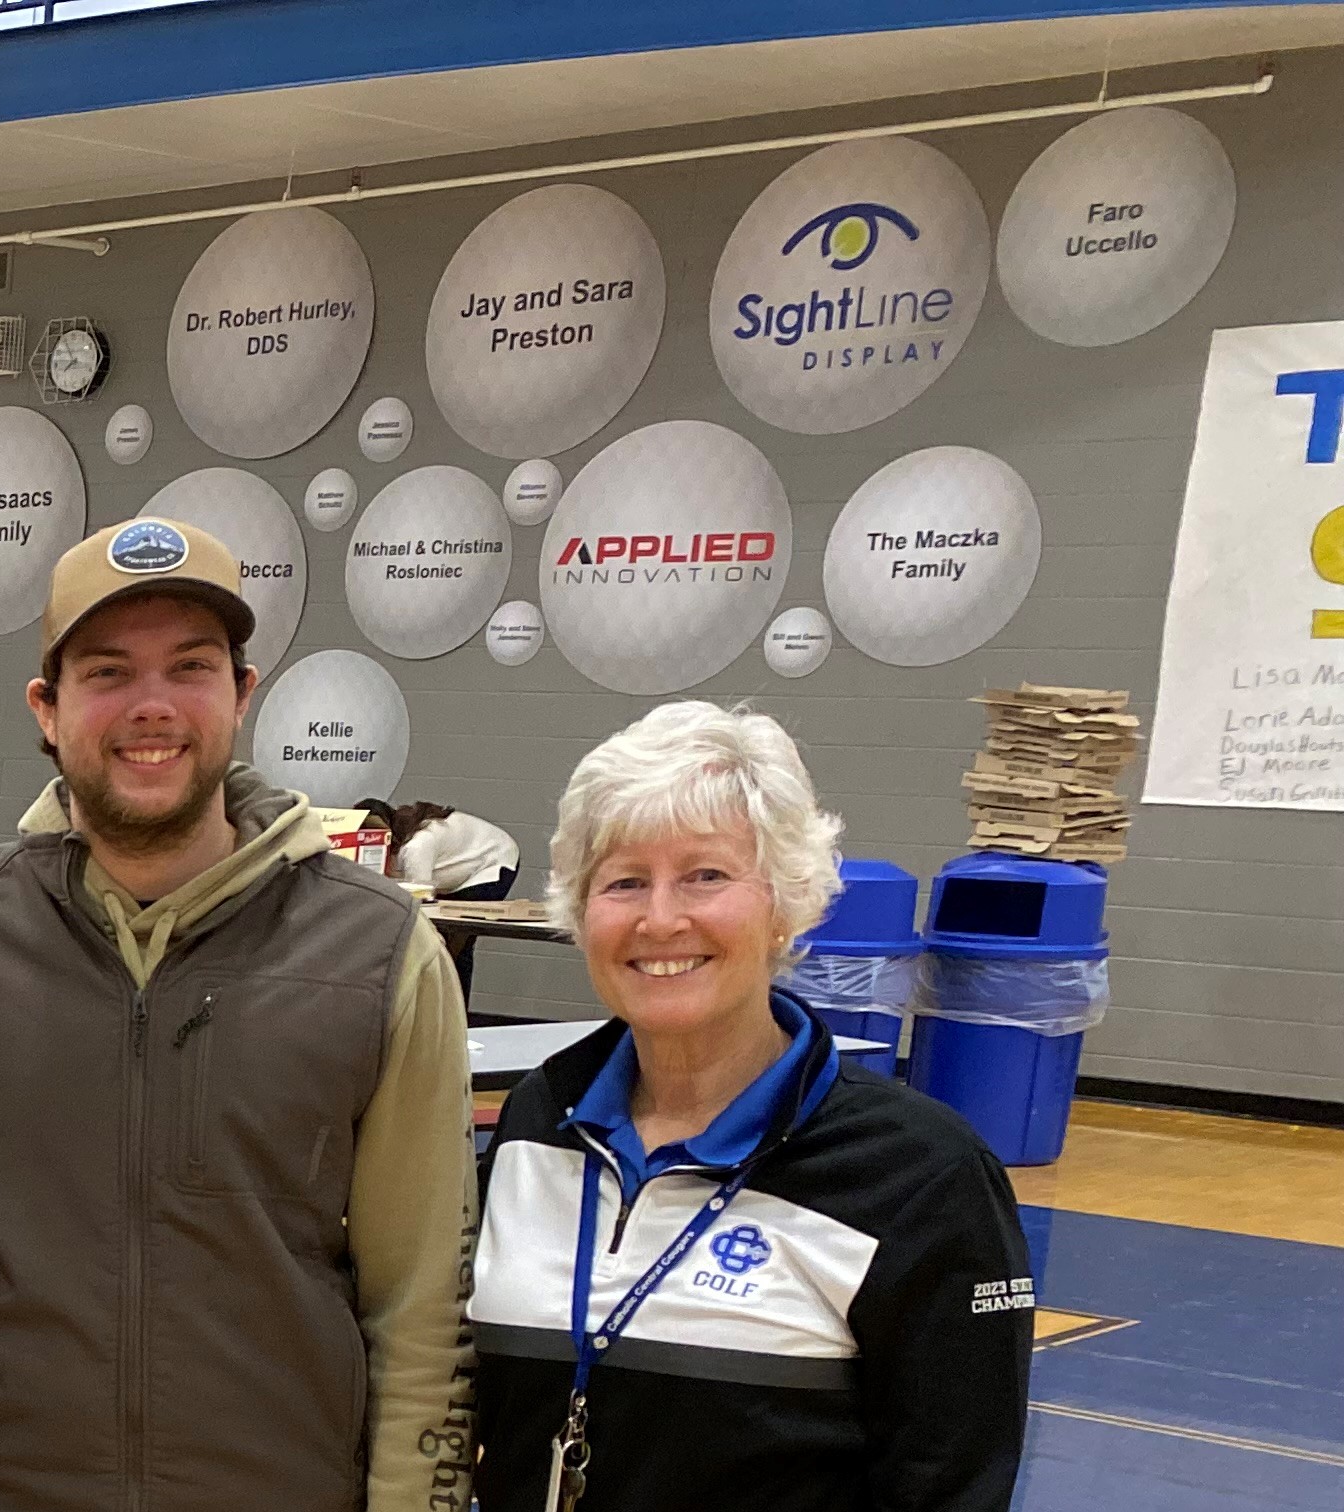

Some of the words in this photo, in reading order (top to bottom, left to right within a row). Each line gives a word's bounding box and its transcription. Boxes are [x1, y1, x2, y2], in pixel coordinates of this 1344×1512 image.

[1087, 201, 1144, 224] Faro
[1065, 231, 1158, 258] Uccello
[461, 293, 505, 321] Jay
[513, 284, 563, 310] and
[571, 278, 634, 304] Sara
[186, 311, 212, 333] Dr.
[218, 304, 284, 330] Robert
[289, 300, 355, 326] Hurley,
[733, 288, 954, 345] SightLine
[246, 334, 289, 356] DDS
[491, 322, 594, 353] Preston
[802, 340, 944, 370] DISPLAY
[353, 540, 411, 558] Michael
[415, 540, 426, 555] &
[430, 538, 504, 555] Christina
[556, 532, 775, 565] APPLIED
[867, 532, 907, 552] The
[915, 528, 1000, 550] Maczka
[240, 560, 292, 578] becca
[385, 564, 463, 580] Rosloniec
[553, 566, 773, 585] INNOVATION
[892, 558, 966, 582] Family
[1232, 664, 1301, 690] Lisa
[308, 721, 353, 739] Kellie
[1224, 708, 1289, 732] Lorie
[282, 746, 377, 763] Berkemeier
[1263, 759, 1331, 774] Moore
[607, 1296, 638, 1332] Catholic
[634, 1266, 663, 1296] Central
[661, 1231, 695, 1266] Cougars
[693, 1270, 759, 1298] GOLF
[973, 1280, 1007, 1298] 2023
